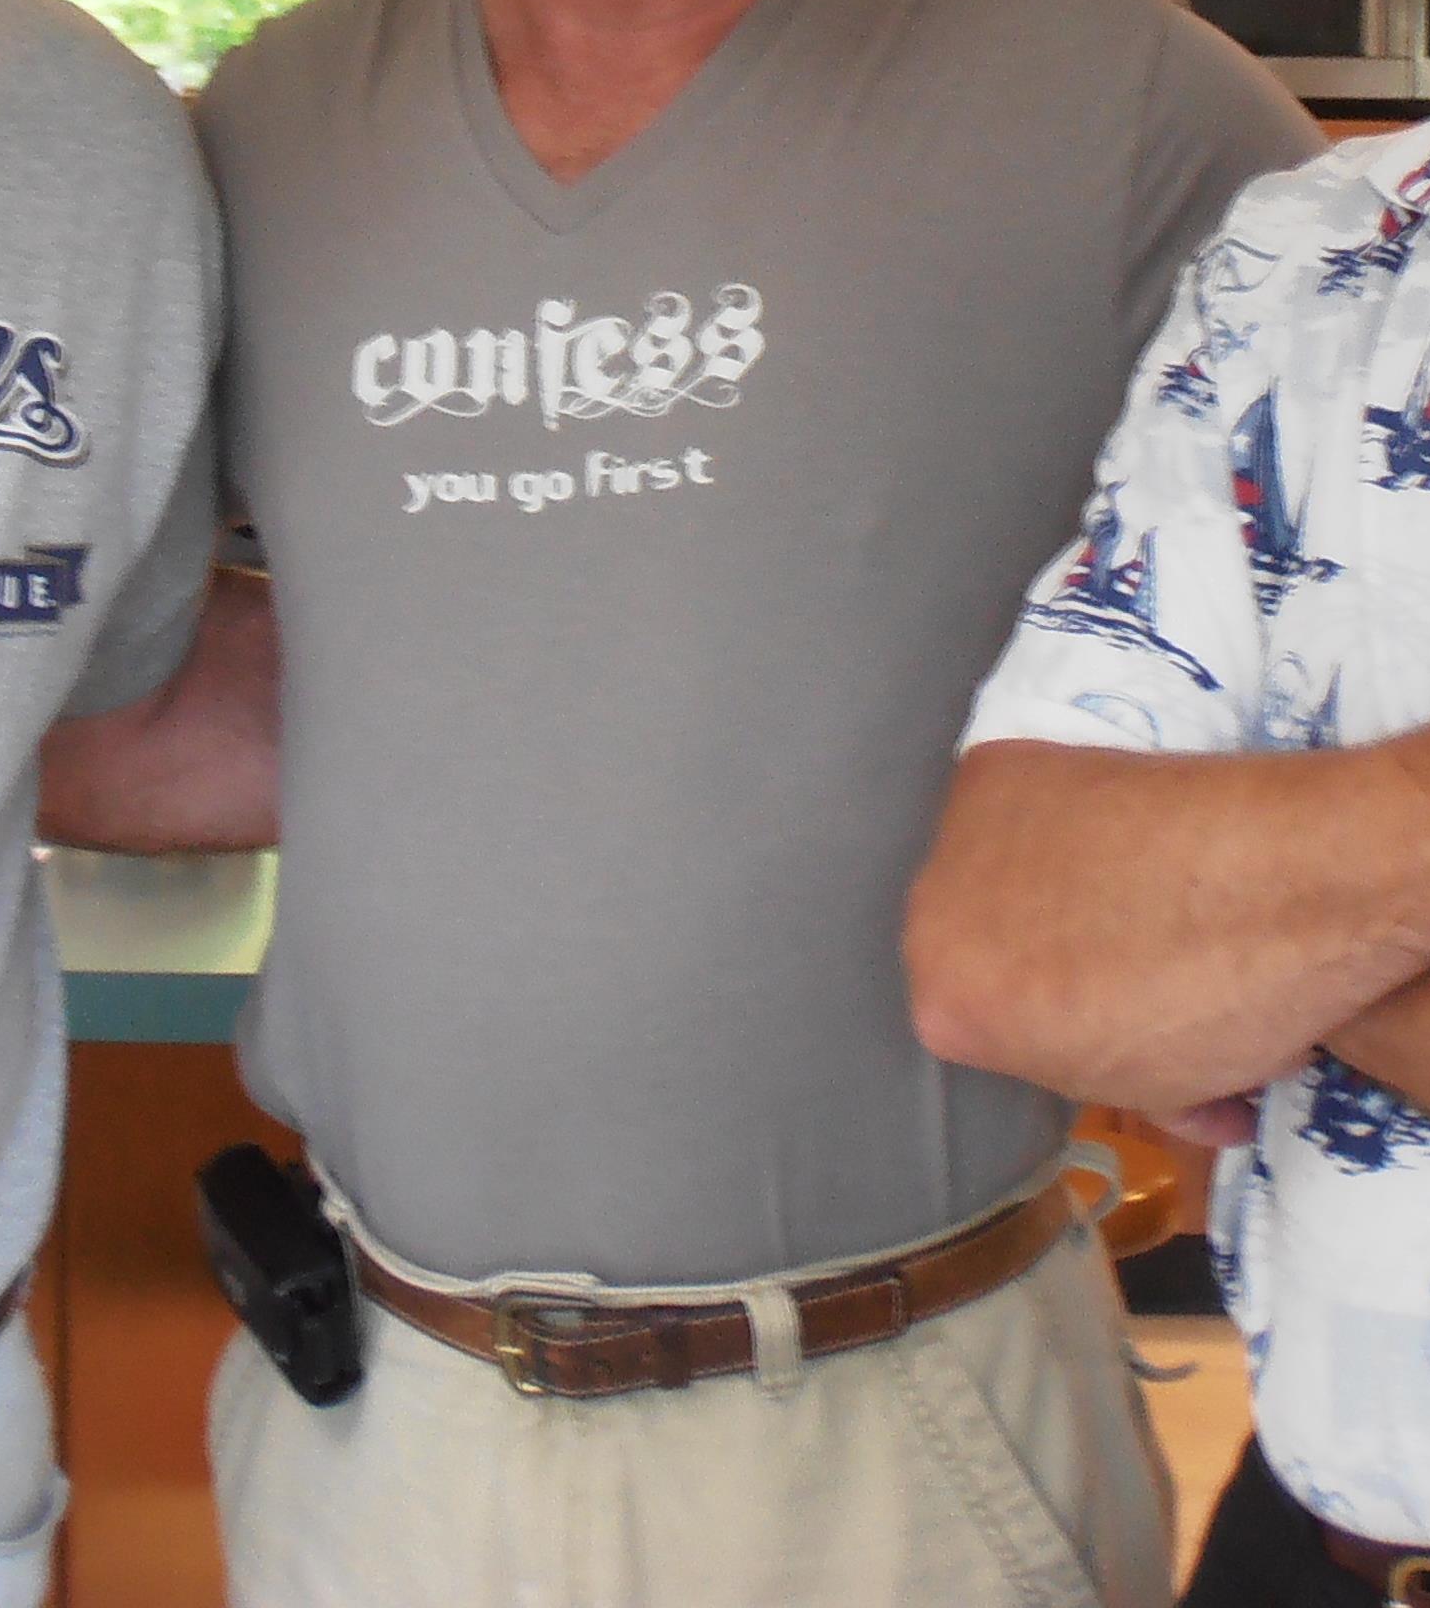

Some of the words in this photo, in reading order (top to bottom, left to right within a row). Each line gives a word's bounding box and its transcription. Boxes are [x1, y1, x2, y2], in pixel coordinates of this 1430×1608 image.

[402, 471, 497, 513] you
[508, 470, 575, 513] go
[585, 446, 714, 497] first
